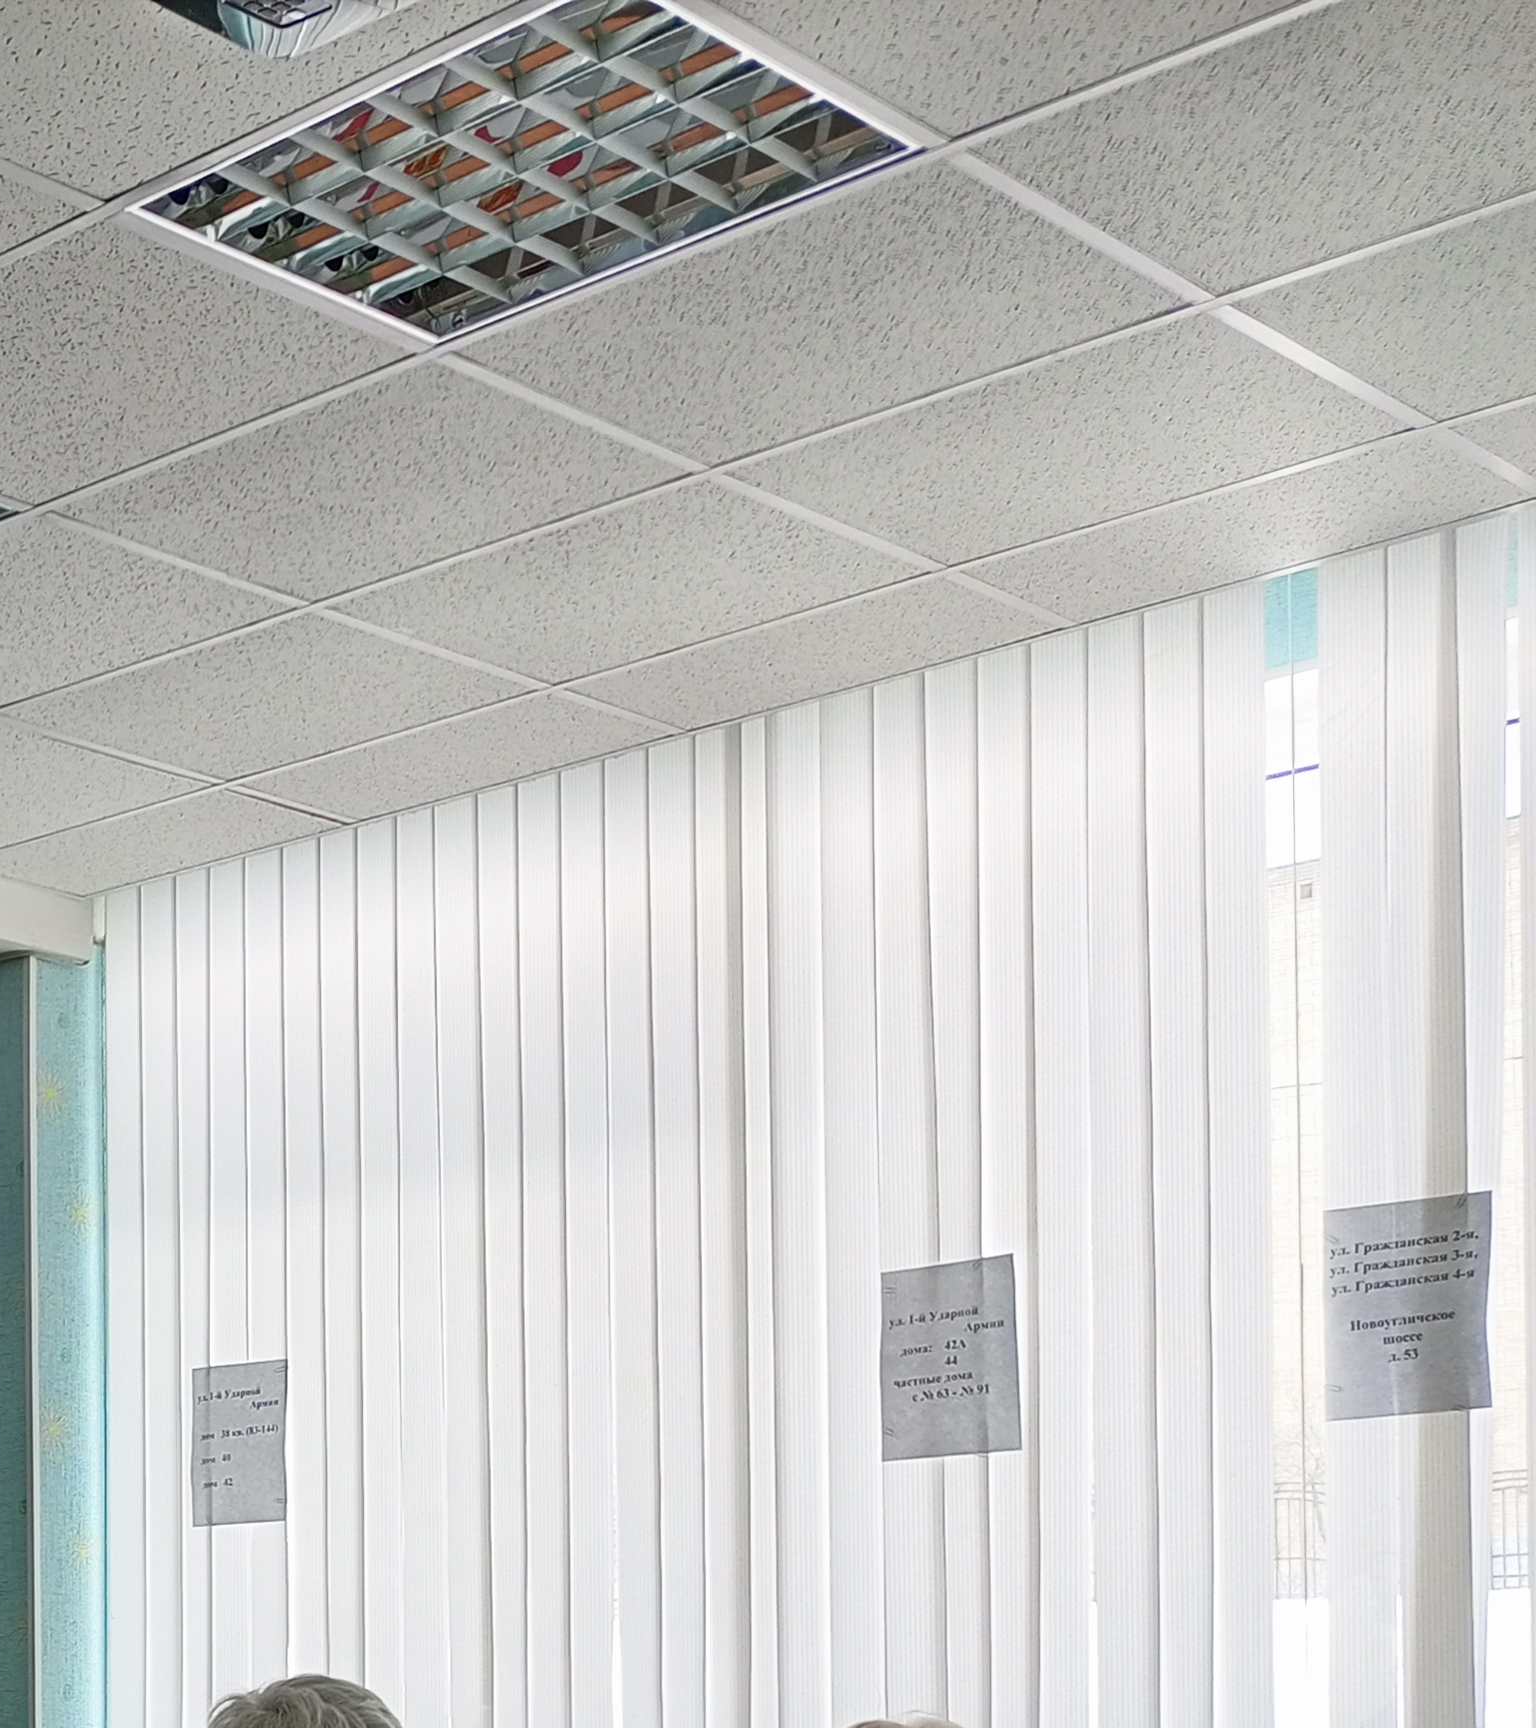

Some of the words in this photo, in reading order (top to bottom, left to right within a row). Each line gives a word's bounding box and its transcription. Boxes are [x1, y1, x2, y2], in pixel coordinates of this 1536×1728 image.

[1330, 1243, 1350, 1259] ул.
[1354, 1233, 1449, 1256] Гражданская
[1329, 1264, 1350, 1278] ул.
[1354, 1254, 1448, 1276] Гражданская
[1331, 1282, 1351, 1297] ул.
[1355, 1271, 1449, 1294] Гражданская
[1452, 1269, 1475, 1280] 4-я
[888, 1316, 905, 1329] ул.
[909, 1313, 927, 1325] 1-й
[929, 1306, 979, 1321] Ударной
[964, 1319, 1005, 1334] Армии
[1350, 1310, 1456, 1331] Новоугличское
[1383, 1332, 1424, 1345] шоссе
[899, 1345, 933, 1357] дома:
[1388, 1351, 1401, 1363] д.
[1403, 1348, 1419, 1360] 53
[944, 1355, 958, 1366] 44
[893, 1376, 942, 1389] частные
[944, 1371, 973, 1384] дома
[920, 1389, 935, 1402] №
[936, 1388, 950, 1399] 63
[960, 1386, 975, 1397] №
[977, 1383, 990, 1395] 91
